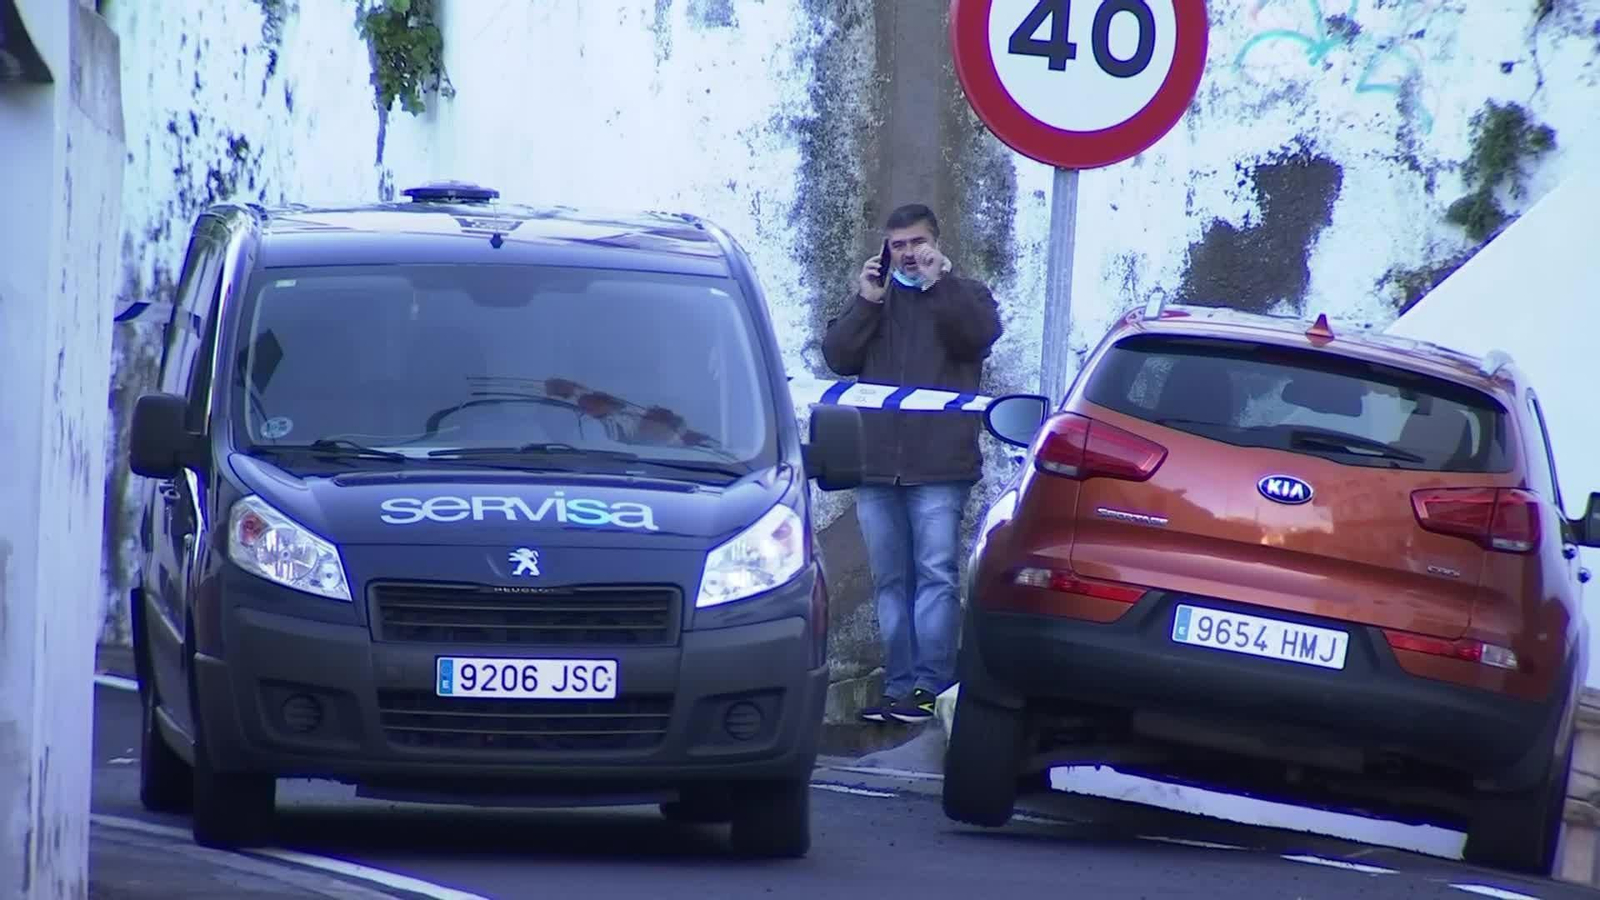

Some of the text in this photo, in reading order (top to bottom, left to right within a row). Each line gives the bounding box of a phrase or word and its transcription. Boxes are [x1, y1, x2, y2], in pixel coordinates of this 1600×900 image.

[1008, 0, 1156, 78] 40
[1267, 478, 1304, 500] KIA
[1196, 616, 1337, 662] 9654 HMJ
[460, 663, 609, 692] 9206 JSC
